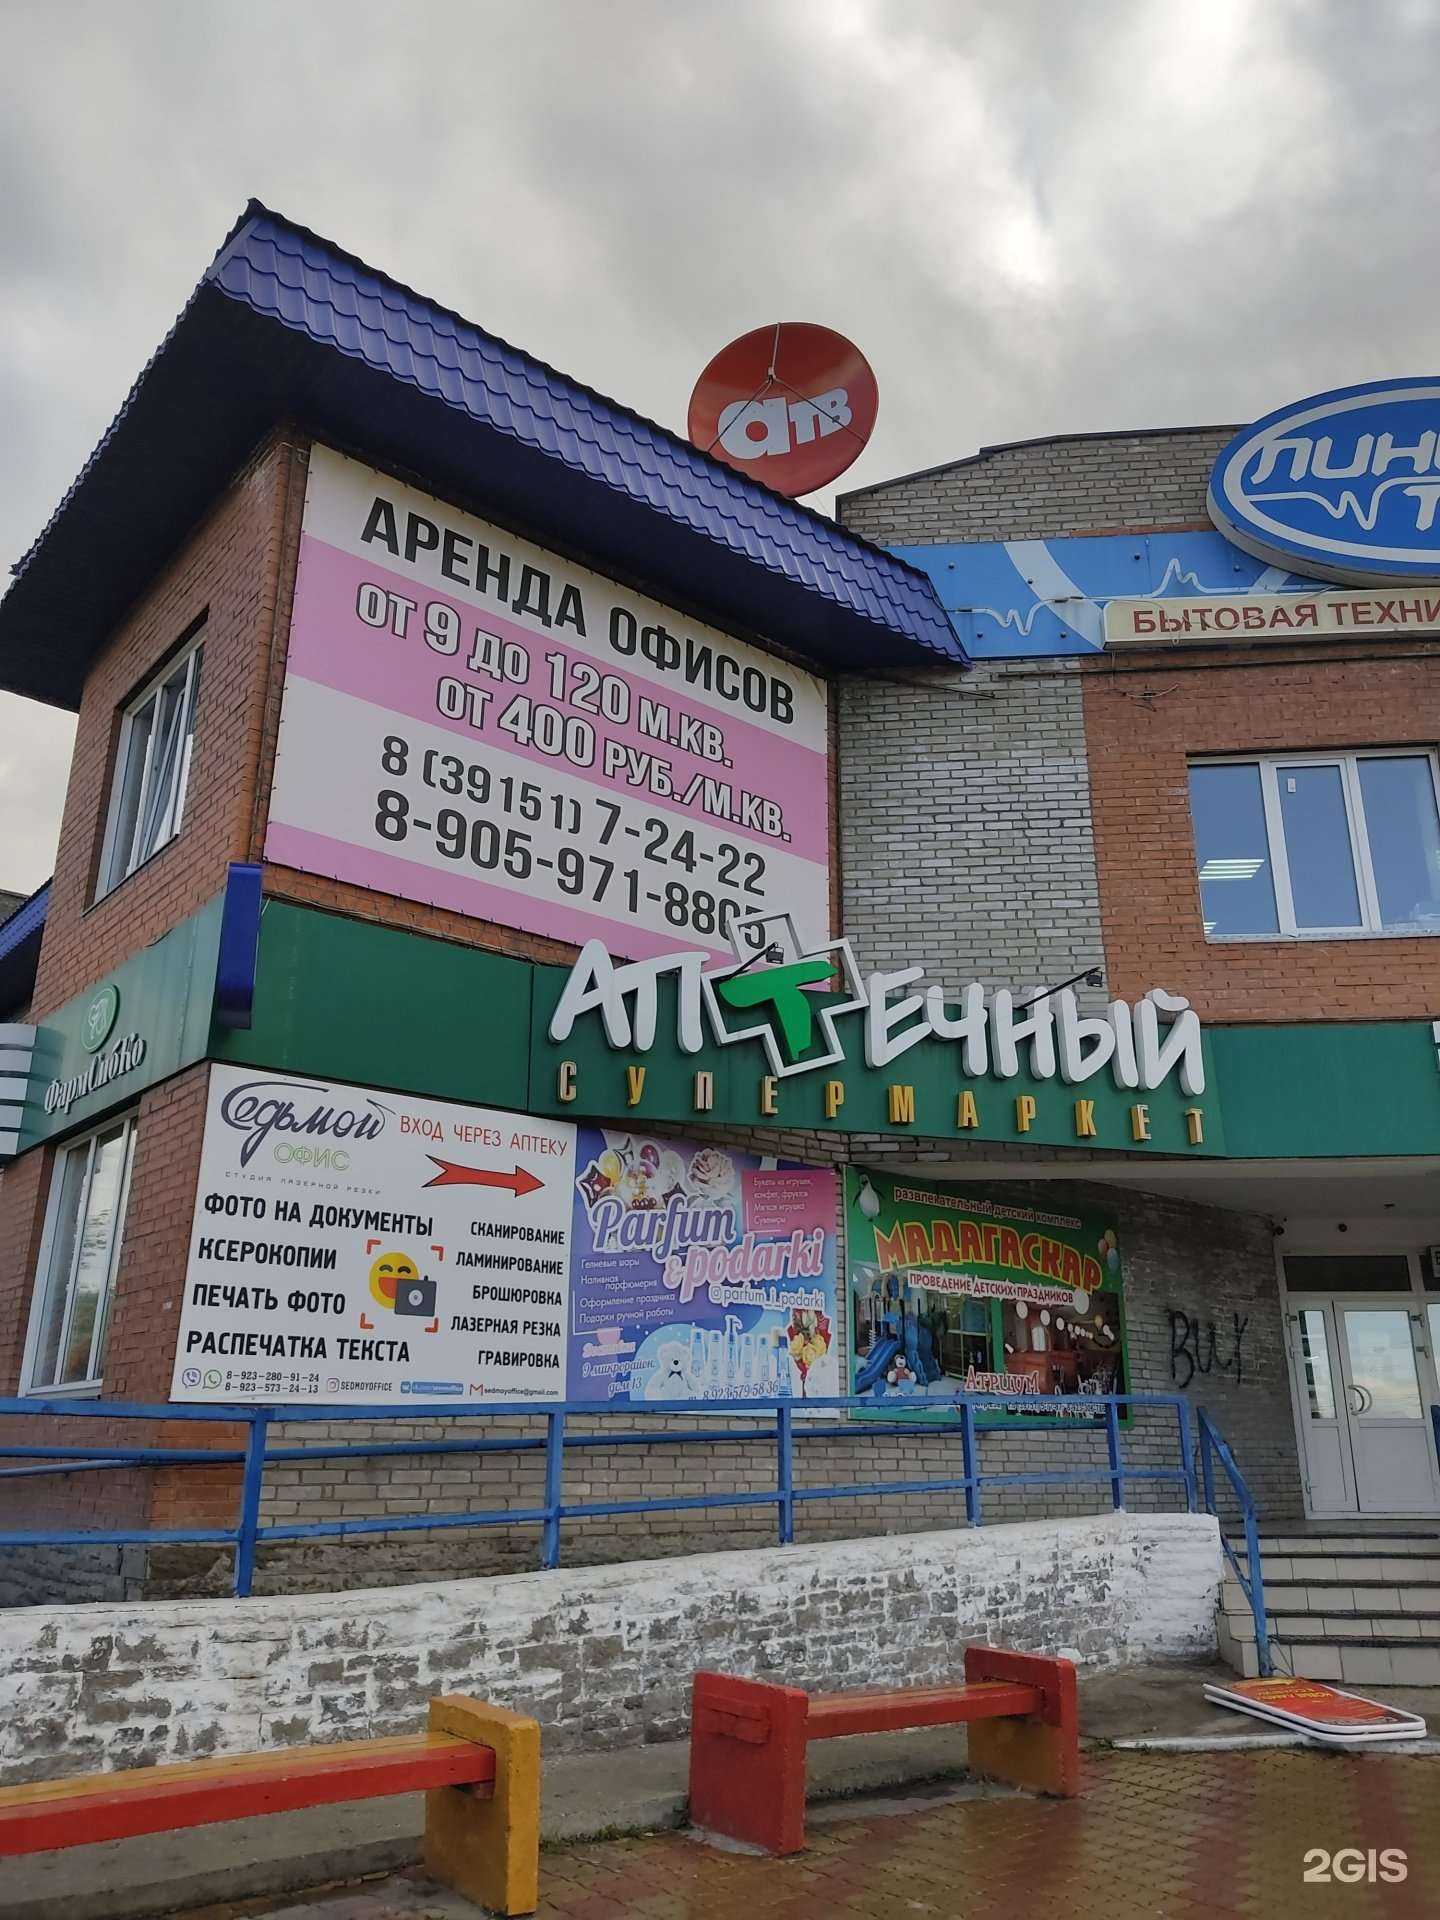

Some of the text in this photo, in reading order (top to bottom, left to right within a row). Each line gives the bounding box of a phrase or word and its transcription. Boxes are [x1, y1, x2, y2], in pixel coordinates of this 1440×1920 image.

[1250, 430, 1440, 485] ЛИН
[361, 496, 796, 725] АРЕНДА ОФИСОВ
[1133, 604, 1318, 634] БЫТОВАЯ
[356, 582, 735, 769] ОТ 9 ДО 120 М.КВ.
[437, 676, 793, 843] ОТ 400 РУБ./М.КВ.
[381, 735, 768, 896] 8 (39151) 7-24-22
[375, 789, 767, 950] 8-905-971-8805
[558, 1060, 1205, 1145] СУПЕРМАРКЕТ
[221, 1081, 397, 1168] Седьмой
[400, 1114, 568, 1157] ВХОД ЧЕРЕЗ АПТЕКУ
[273, 1142, 351, 1171] ОФИС
[204, 1192, 433, 1237] ФОТО НА ДОКУМЕНТЫ
[895, 1188, 1081, 1229] развлекательный детский комплекс
[470, 1221, 565, 1245] СКАНИРОВАНИЕ
[592, 1195, 736, 1262] Parfum
[198, 1238, 337, 1270] КСЕРОКОПИИ
[455, 1251, 563, 1275] ЛАМИНИРОВАНИЕ
[874, 1221, 1102, 1295] МАДАГАСКАР
[192, 1283, 346, 1315] ПЕЧАТЬ ФОТО
[472, 1285, 562, 1306] БРОШЮРОВКА
[909, 1271, 1073, 1304] ПРОВЕДЕНИЕ ДЕТСКИХ ПРАЗДНИКОВ
[451, 1316, 561, 1337] ЛАЗЕРНАЯ РЕЗКА
[186, 1330, 410, 1362] РАСПЕЧАТКА ТЕКСТА
[478, 1350, 560, 1369] ГРАВИРОВКА
[225, 1383, 319, 1393] 8-923-573-24-13
[226, 1371, 320, 1382] 8-923-280-91-24
